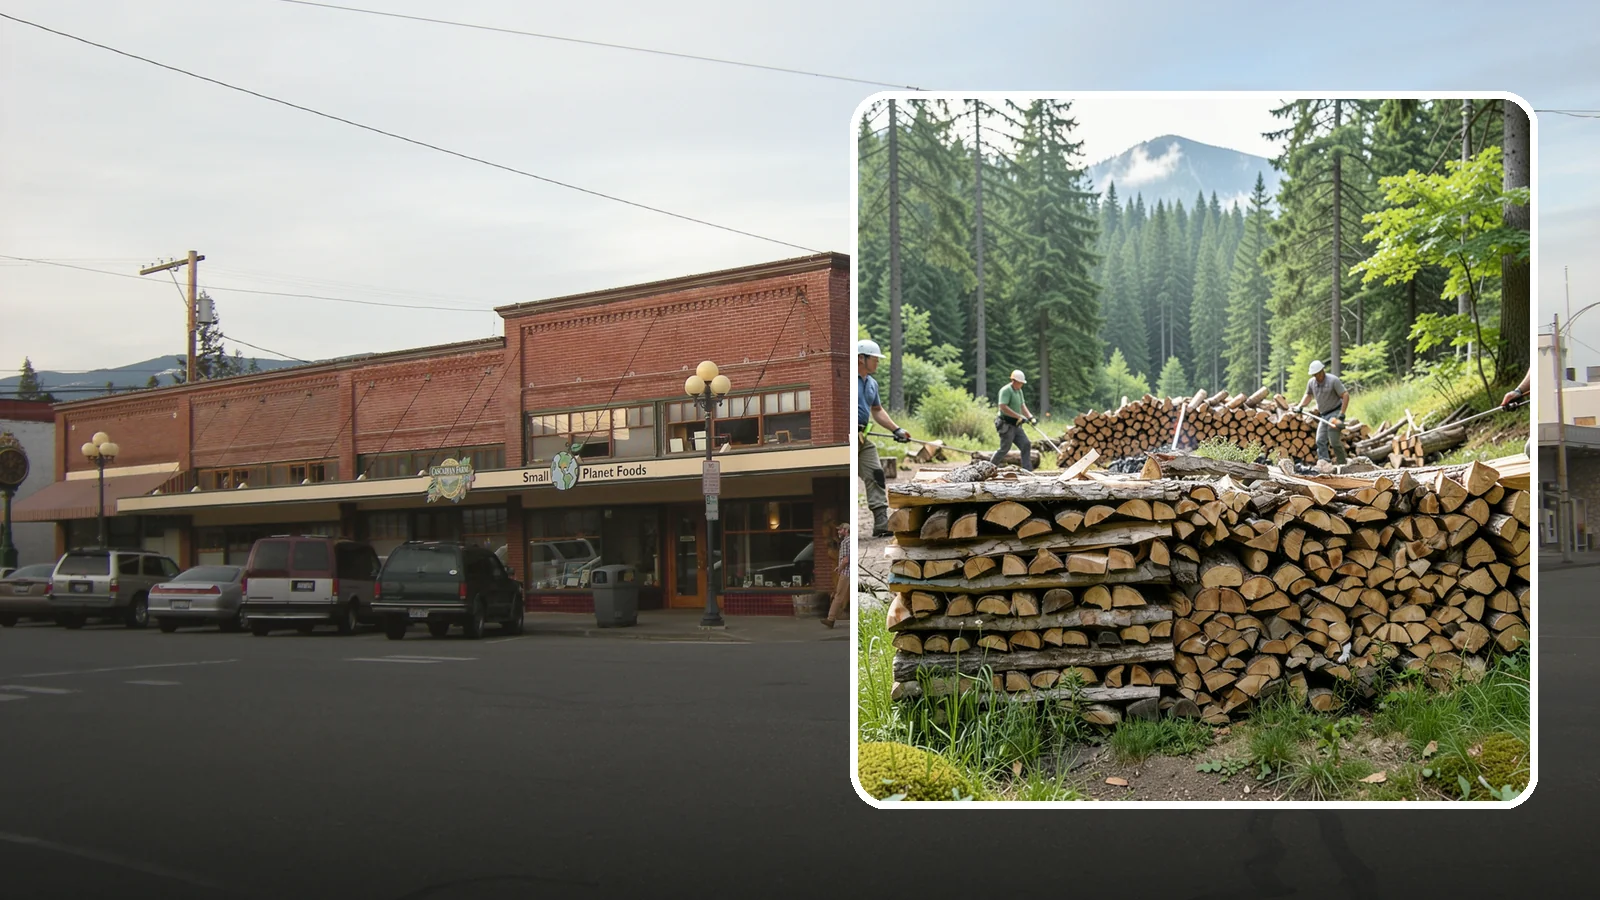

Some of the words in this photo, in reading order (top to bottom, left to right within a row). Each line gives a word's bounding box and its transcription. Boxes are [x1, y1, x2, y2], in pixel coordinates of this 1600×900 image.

[523, 471, 549, 482] Small
[583, 467, 614, 479] Planet
[617, 464, 647, 477] Foods
